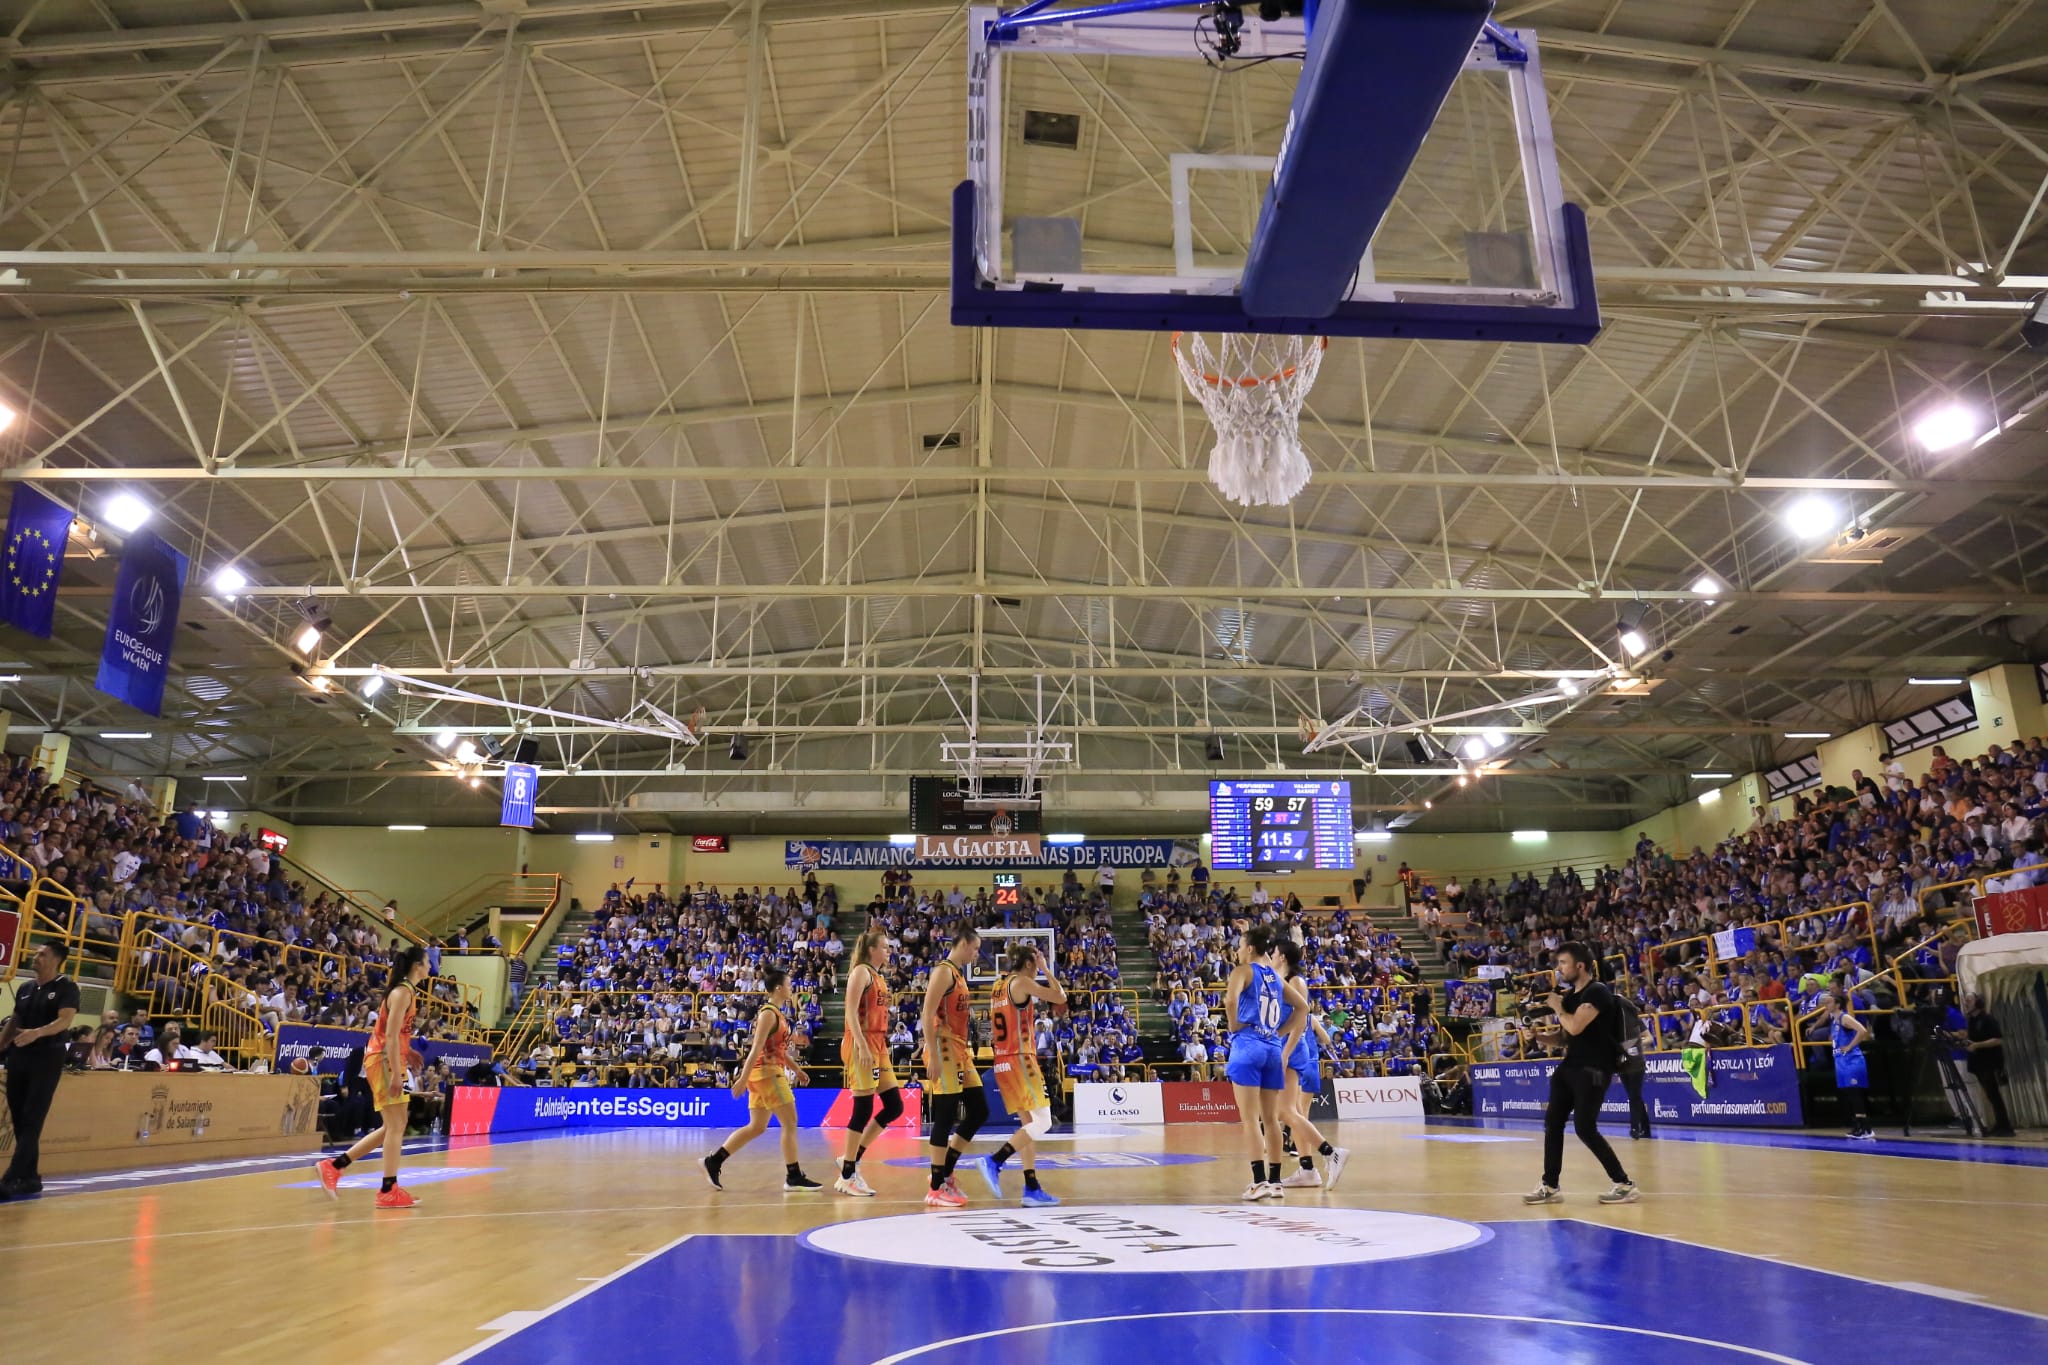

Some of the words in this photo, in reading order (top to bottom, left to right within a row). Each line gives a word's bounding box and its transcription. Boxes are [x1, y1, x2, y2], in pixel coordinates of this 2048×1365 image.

[514, 778, 526, 800] 8
[1254, 797, 1274, 811] 59
[1287, 797, 1307, 811] 57
[1261, 832, 1292, 846] 11.5
[1074, 846, 1096, 865] DE
[1100, 845, 1166, 865] EUROPA
[1263, 849, 1272, 860] 3
[1293, 849, 1303, 860] 4
[995, 875, 1015, 883] 11.5
[997, 889, 1018, 904] 24
[1259, 995, 1280, 1028] 10
[1746, 1056, 1752, 1071] Y
[1754, 1053, 1775, 1069] LEÓN
[1337, 1088, 1418, 1104] REVLON
[1110, 1108, 1140, 1116] GANSO
[1179, 1102, 1213, 1111] Elizabeth
[1213, 1102, 1236, 1111] Arden
[1690, 1100, 1787, 1117] perfumeriasavenida.com
[166, 1118, 174, 1129] de
[937, 1212, 1115, 1267] CASTILLA
